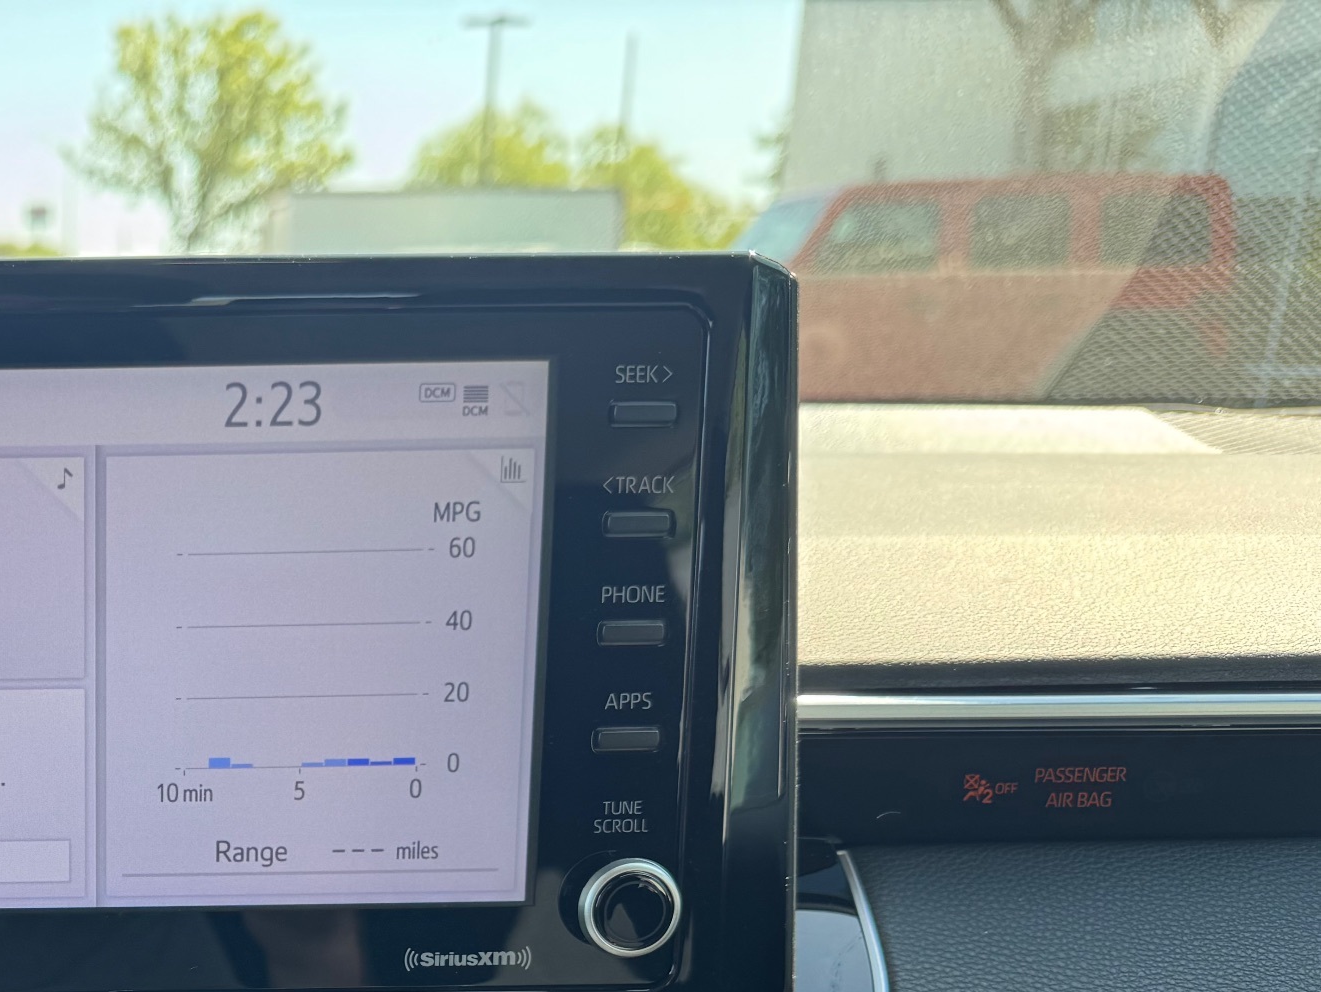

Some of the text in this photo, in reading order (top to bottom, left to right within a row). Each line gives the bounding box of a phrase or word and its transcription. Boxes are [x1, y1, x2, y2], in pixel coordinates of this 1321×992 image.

[424, 387, 451, 399] DCM
[224, 380, 323, 428] 2:23
[462, 405, 489, 417] DCM
[433, 501, 482, 523] MPG
[449, 536, 476, 560] 60
[601, 586, 666, 604] PHONE
[445, 610, 473, 632] 40
[444, 682, 470, 704] 20
[605, 692, 652, 711] APPS
[447, 753, 460, 774] 0
[1034, 767, 1127, 783] PASSENGER
[157, 783, 214, 803] 10 min
[293, 781, 306, 801] 5
[409, 779, 423, 799] 0
[995, 782, 1019, 795] OFF
[603, 801, 643, 816] TUNE
[1045, 792, 1112, 808] AIR BAG
[593, 819, 649, 834] SCROLL
[215, 841, 288, 867] Range
[396, 841, 439, 862] miles
